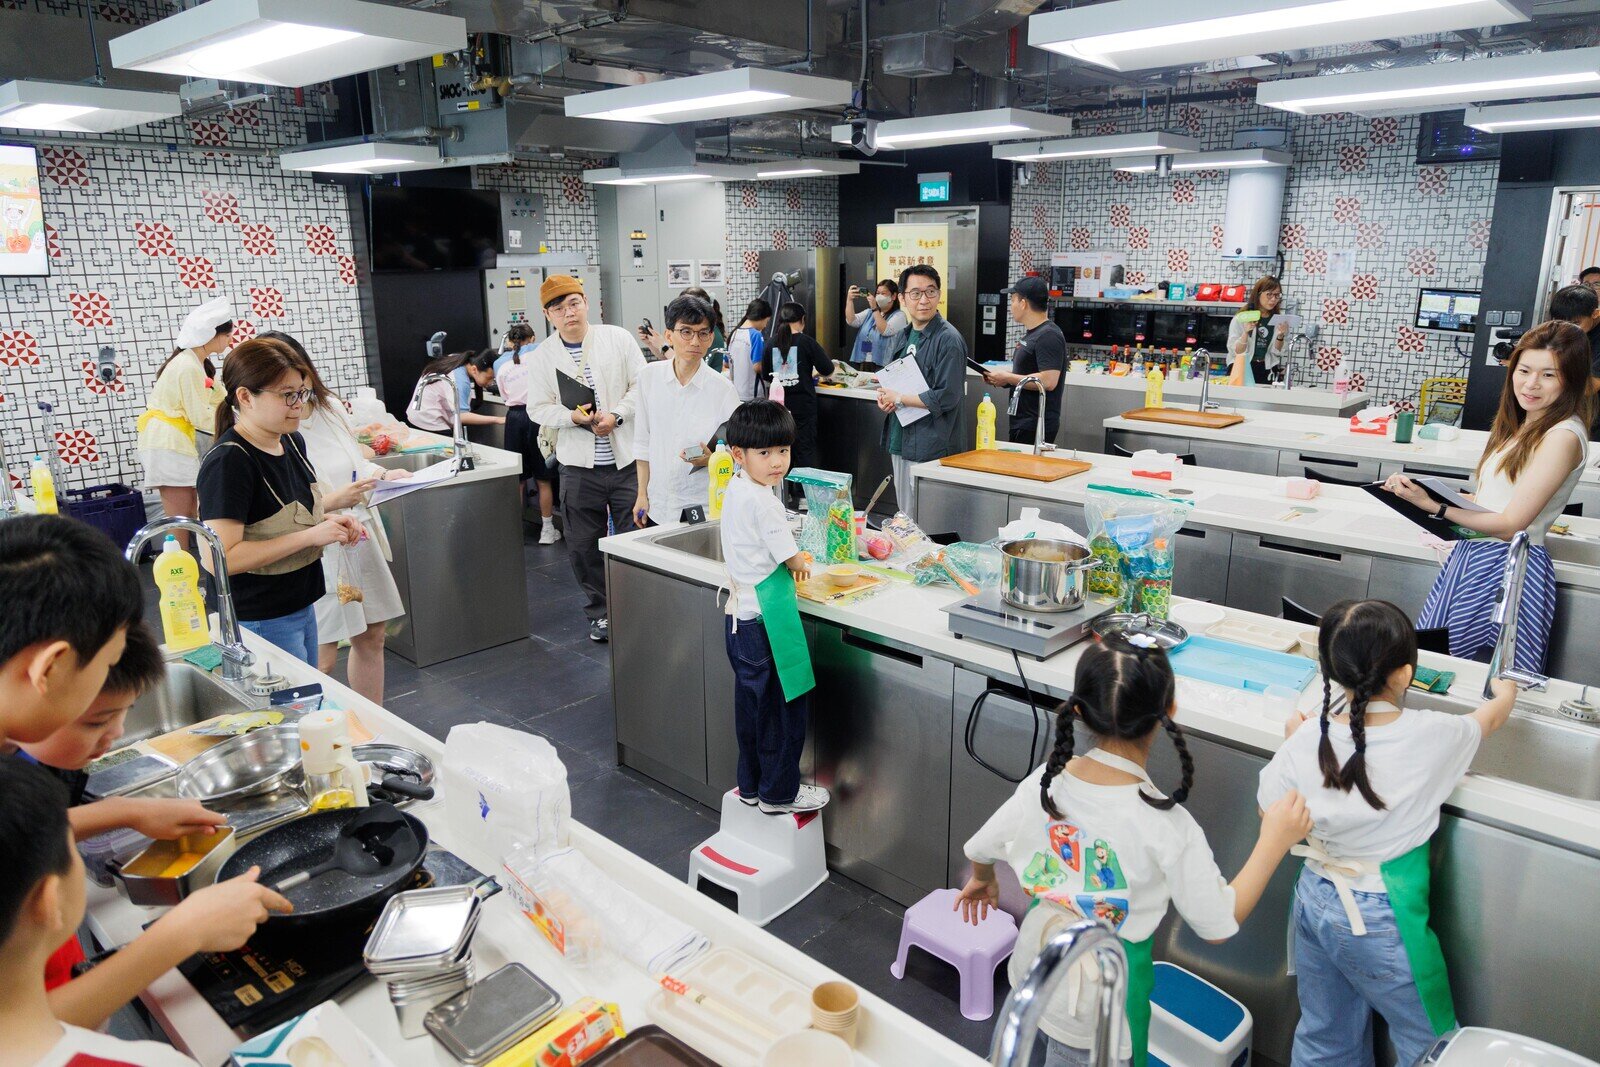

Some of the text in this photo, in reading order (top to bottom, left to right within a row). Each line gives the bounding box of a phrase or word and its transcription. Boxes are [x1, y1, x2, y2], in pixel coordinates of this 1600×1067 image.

[440, 83, 486, 100] SMOG-
[462, 459, 469, 469] 4
[691, 509, 699, 520] 3
[170, 567, 184, 575] AXE
